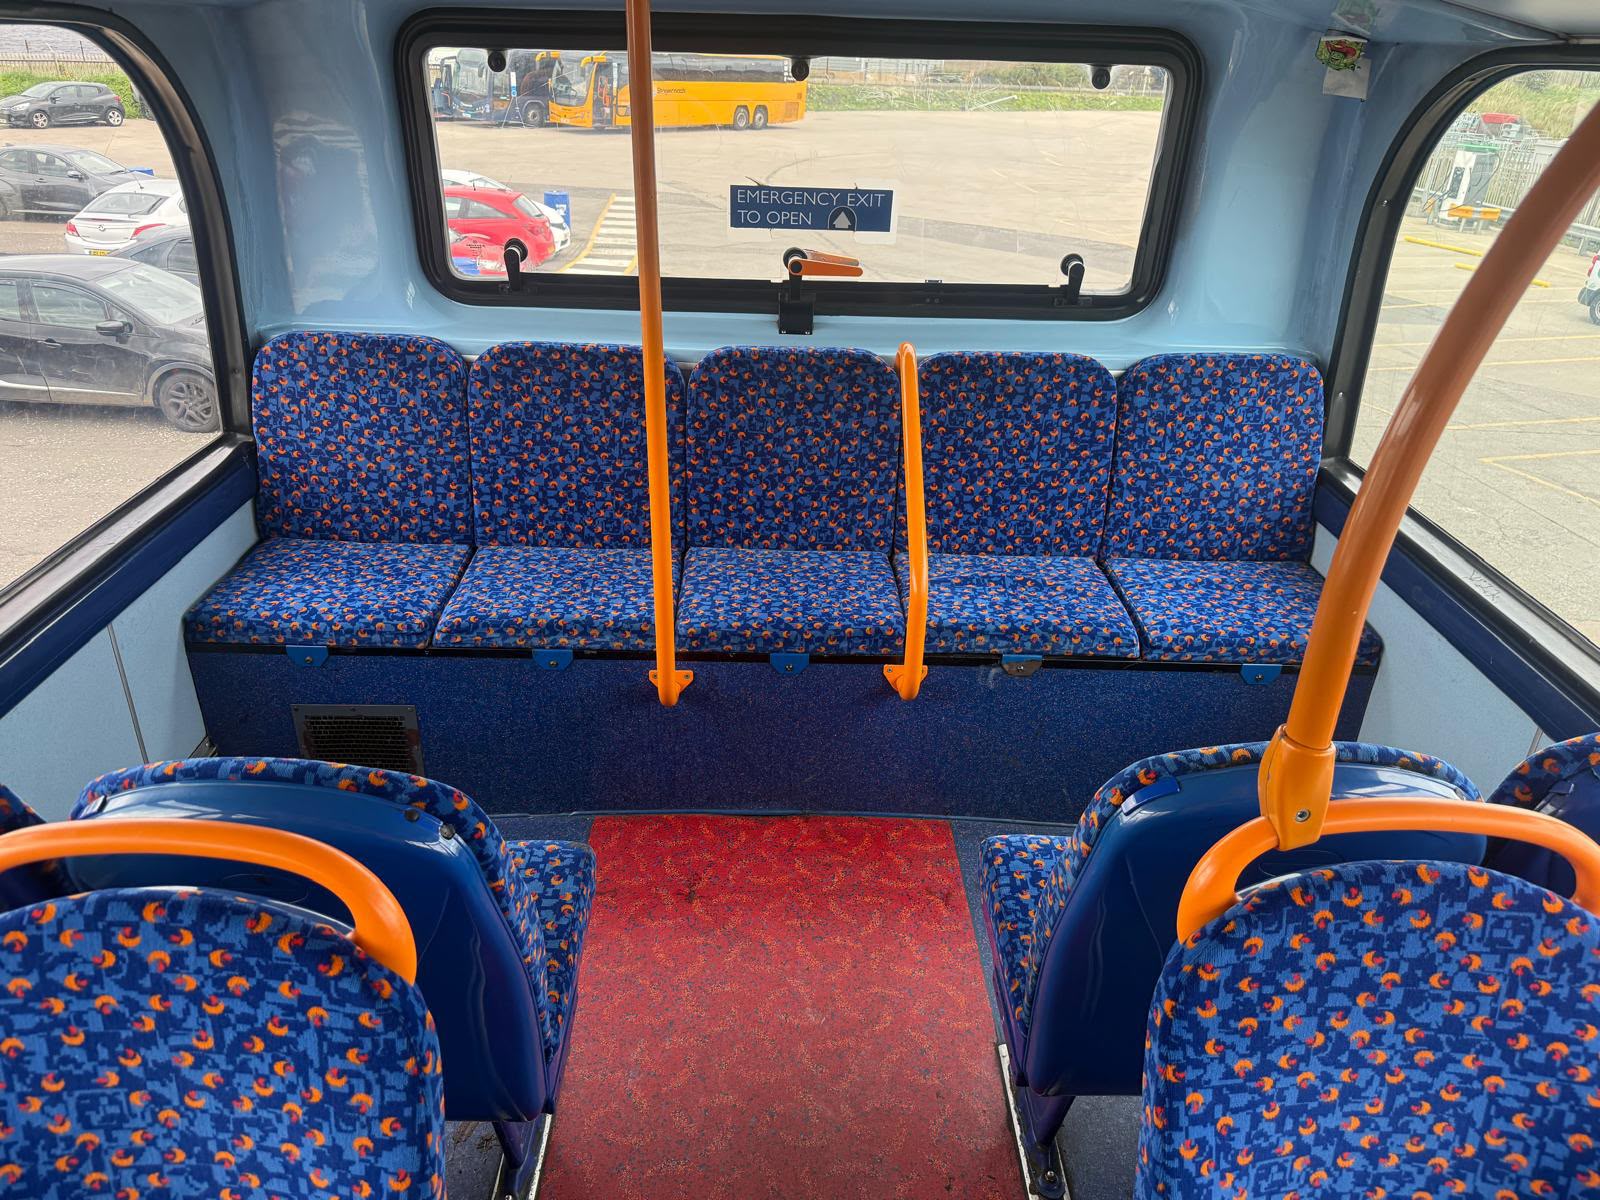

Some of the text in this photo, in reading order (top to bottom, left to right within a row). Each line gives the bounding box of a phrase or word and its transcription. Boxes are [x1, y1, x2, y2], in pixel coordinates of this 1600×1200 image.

[737, 189, 886, 207] EMERGENCY EXIT
[737, 210, 812, 225] TO OPEN
